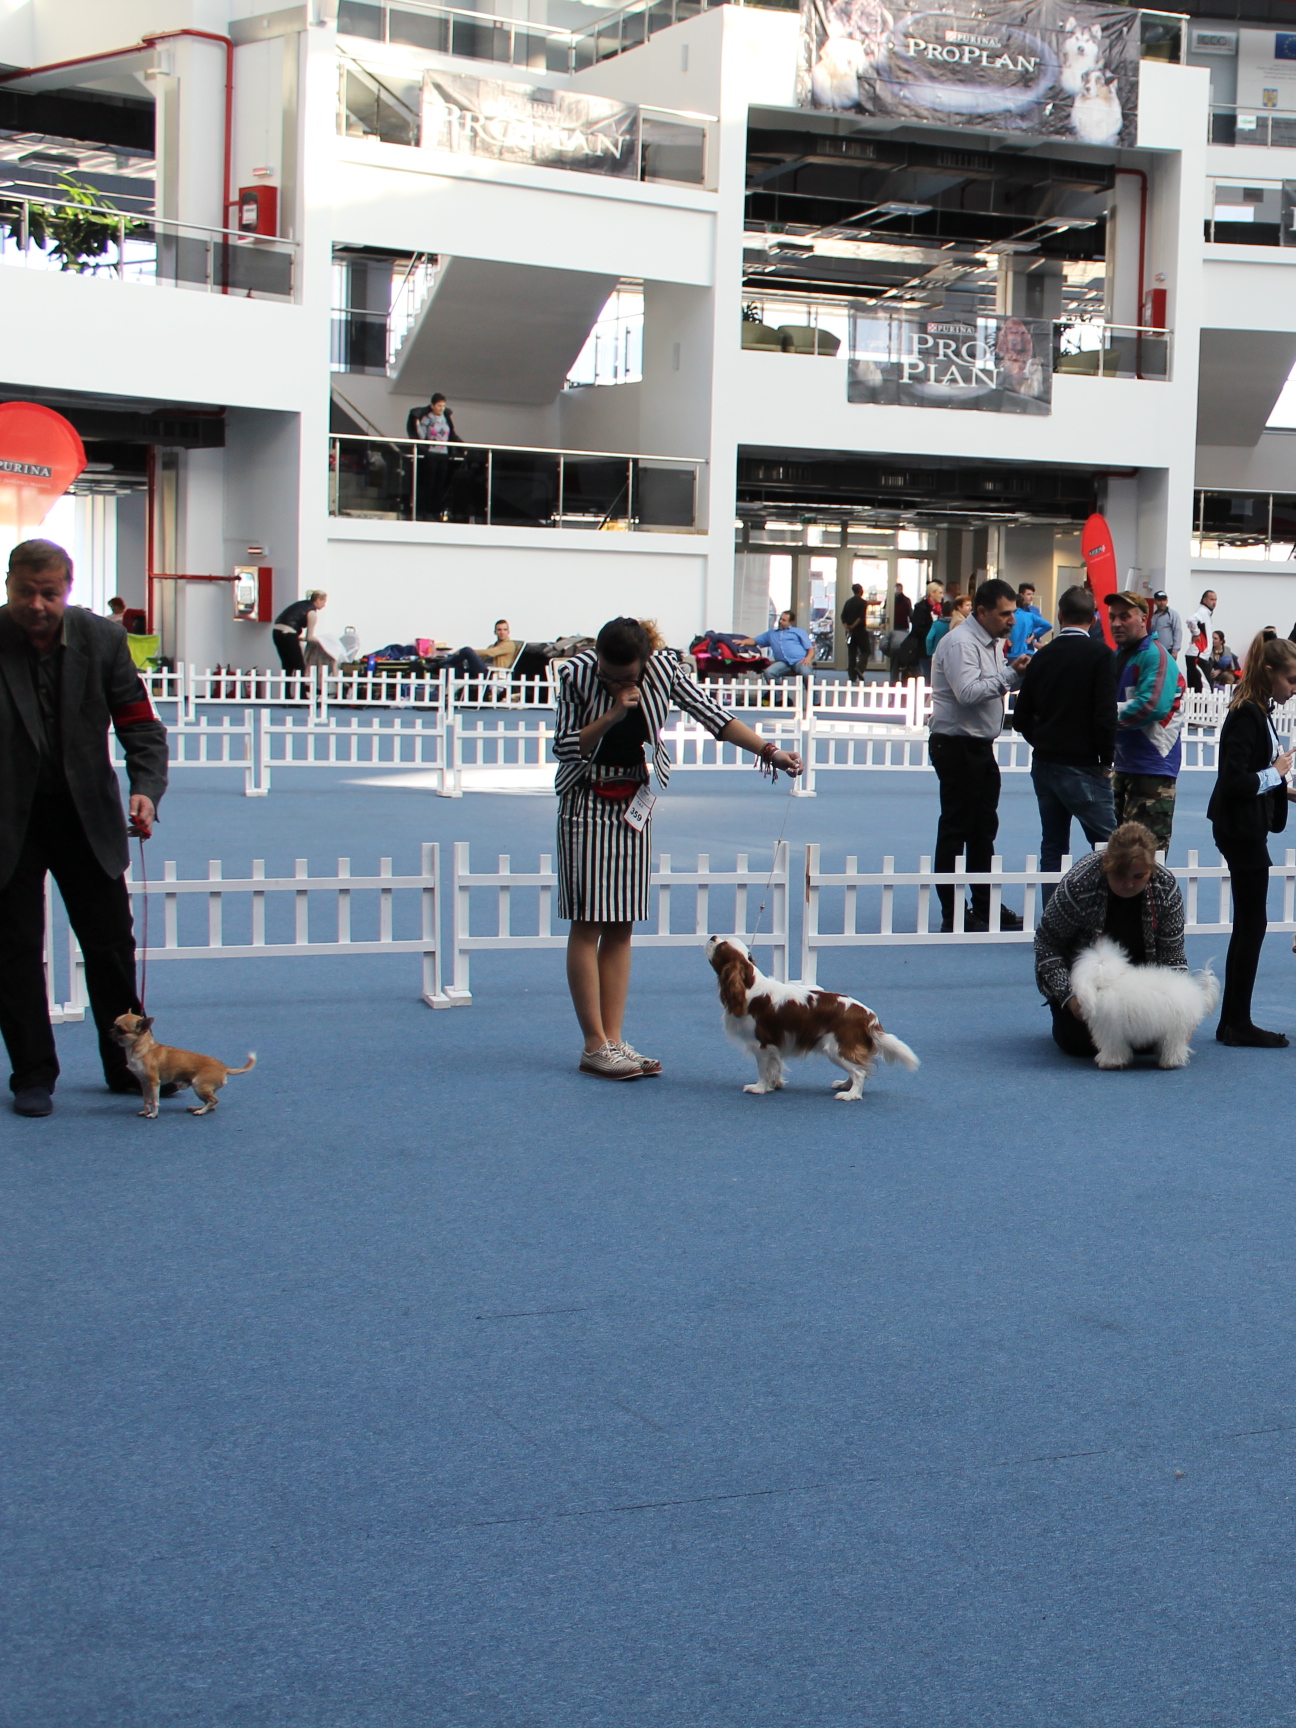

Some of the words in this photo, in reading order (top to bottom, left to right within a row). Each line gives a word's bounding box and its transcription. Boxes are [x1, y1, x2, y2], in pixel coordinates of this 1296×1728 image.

[957, 32, 998, 47] PURINA
[937, 324, 974, 335] PURINA
[909, 332, 992, 367] PRO
[898, 358, 1000, 389] PLAN
[630, 807, 643, 822] 359
